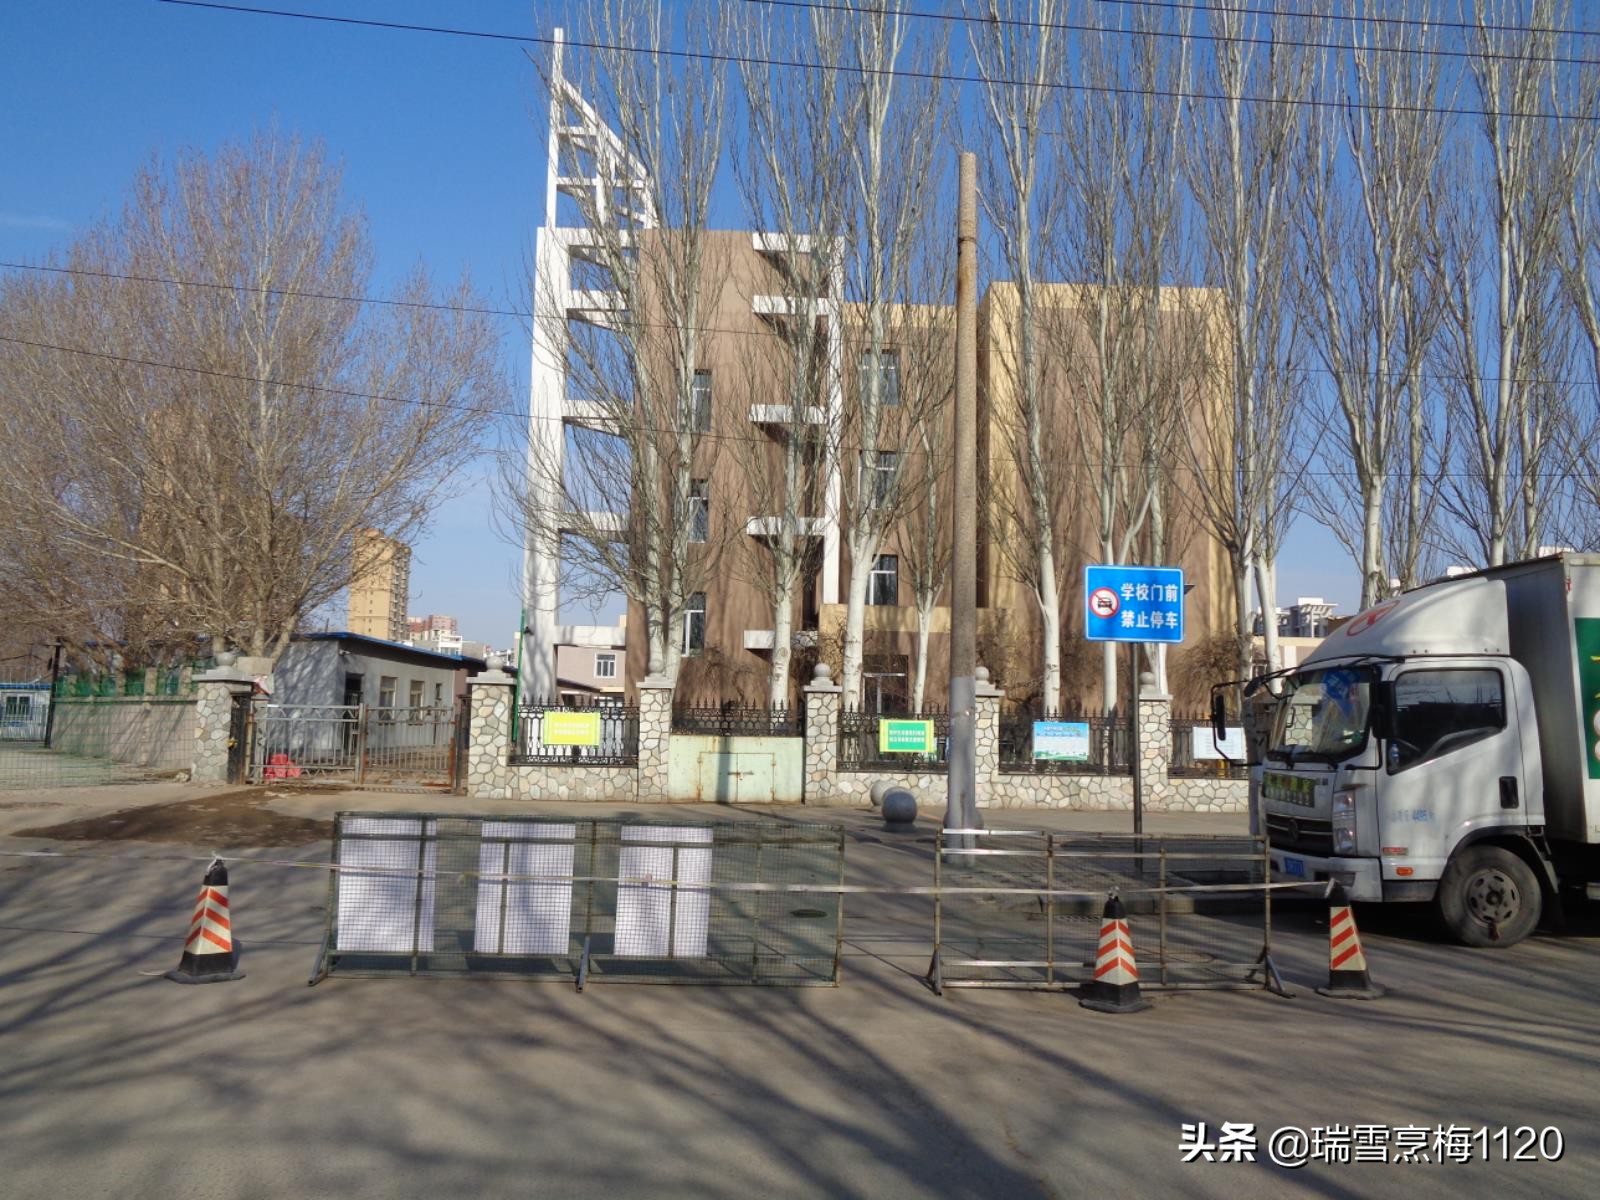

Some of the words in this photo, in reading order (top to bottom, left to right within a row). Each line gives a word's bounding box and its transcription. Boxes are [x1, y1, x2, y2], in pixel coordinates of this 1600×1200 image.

[1121, 582, 1178, 602] 学校门前
[1121, 611, 1178, 629] 禁止停车
